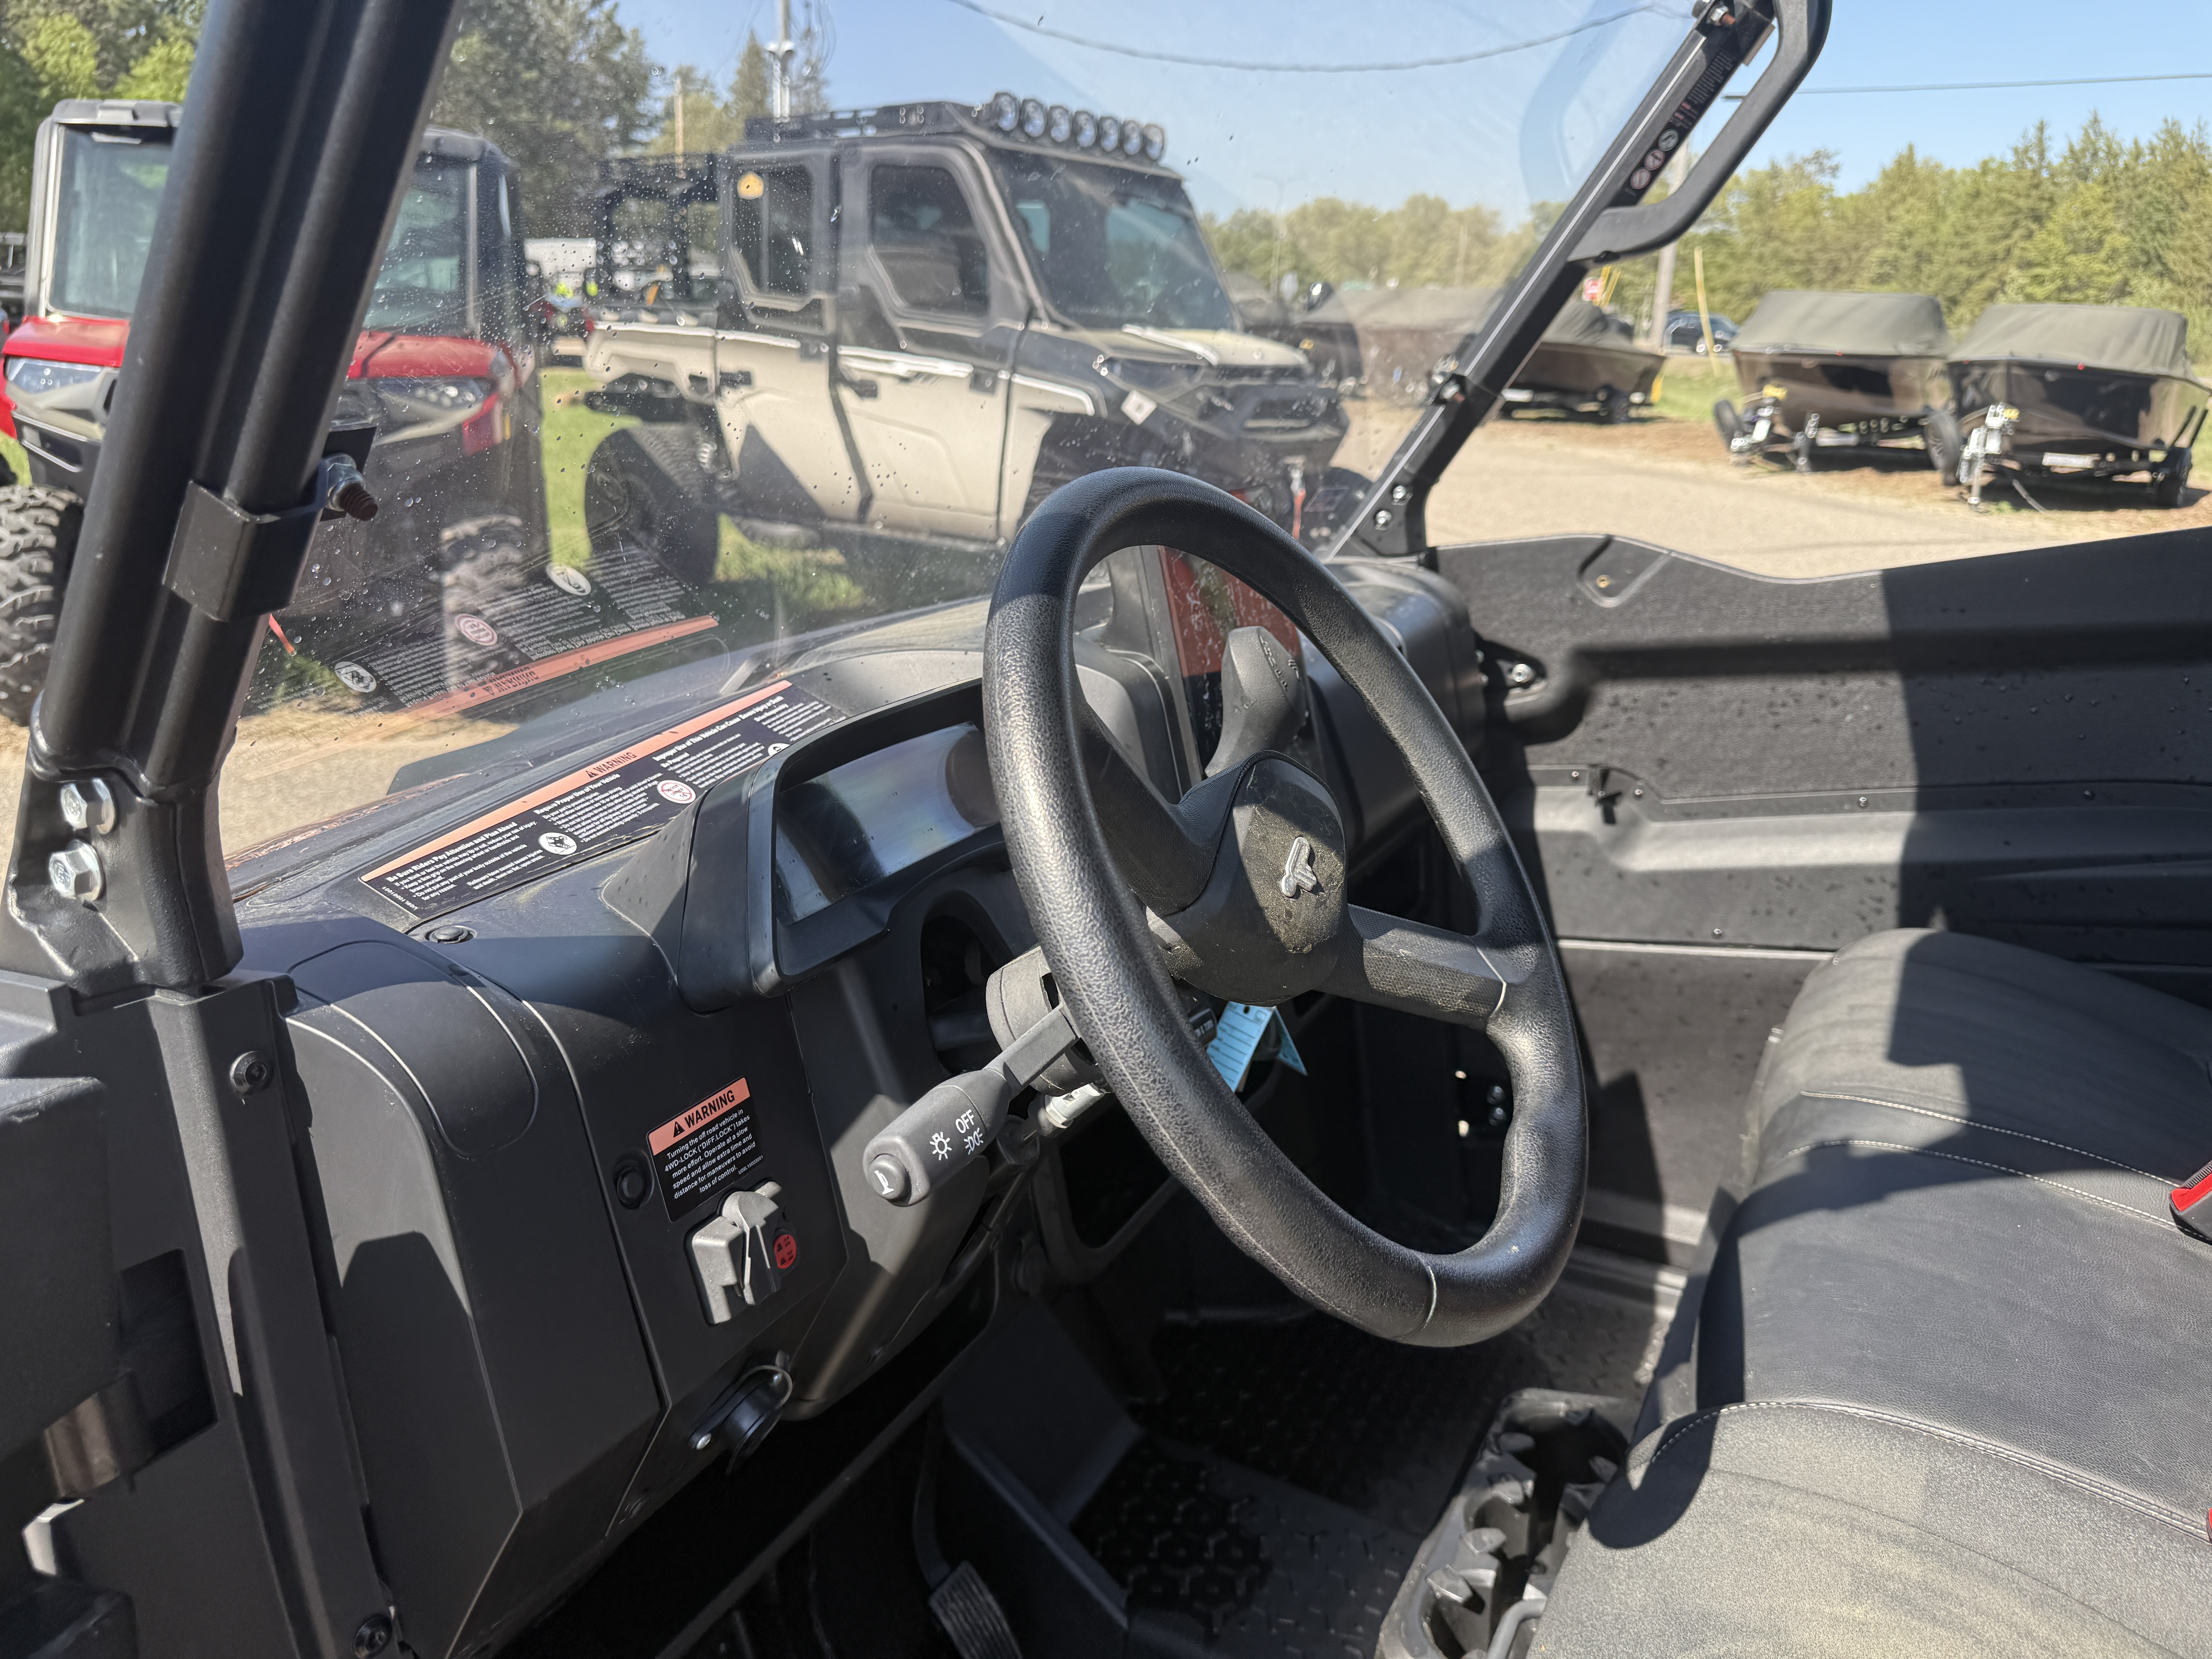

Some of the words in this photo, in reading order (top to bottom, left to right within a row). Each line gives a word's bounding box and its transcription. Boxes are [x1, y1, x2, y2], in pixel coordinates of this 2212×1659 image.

[593, 752, 637, 775] WARNING
[396, 869, 414, 877] Sure
[411, 860, 435, 871] Riders
[445, 842, 475, 856] Attention
[496, 822, 517, 833] Ahead
[684, 1090, 735, 1128] WARNING
[956, 1109, 975, 1133] OFF
[665, 1147, 697, 1171] 4WD-LOCK
[736, 1115, 750, 1127] takes
[667, 1144, 689, 1159] Turning
[689, 1138, 698, 1146] the
[707, 1123, 719, 1135] road
[720, 1113, 737, 1127] vehicle
[673, 1166, 687, 1178] more
[688, 1156, 704, 1168] effort.
[704, 1142, 725, 1158] Operate
[737, 1127, 747, 1137] slow
[673, 1173, 690, 1189] speed
[691, 1166, 701, 1177] and
[702, 1158, 716, 1170] allow
[717, 1149, 730, 1160] extra
[731, 1141, 742, 1151] time
[743, 1133, 752, 1143] and
[675, 1181, 697, 1199] distance
[707, 1156, 735, 1178] maneuvers
[742, 1141, 755, 1154] avoid
[700, 1183, 711, 1193] loss
[718, 1165, 737, 1180] control.
